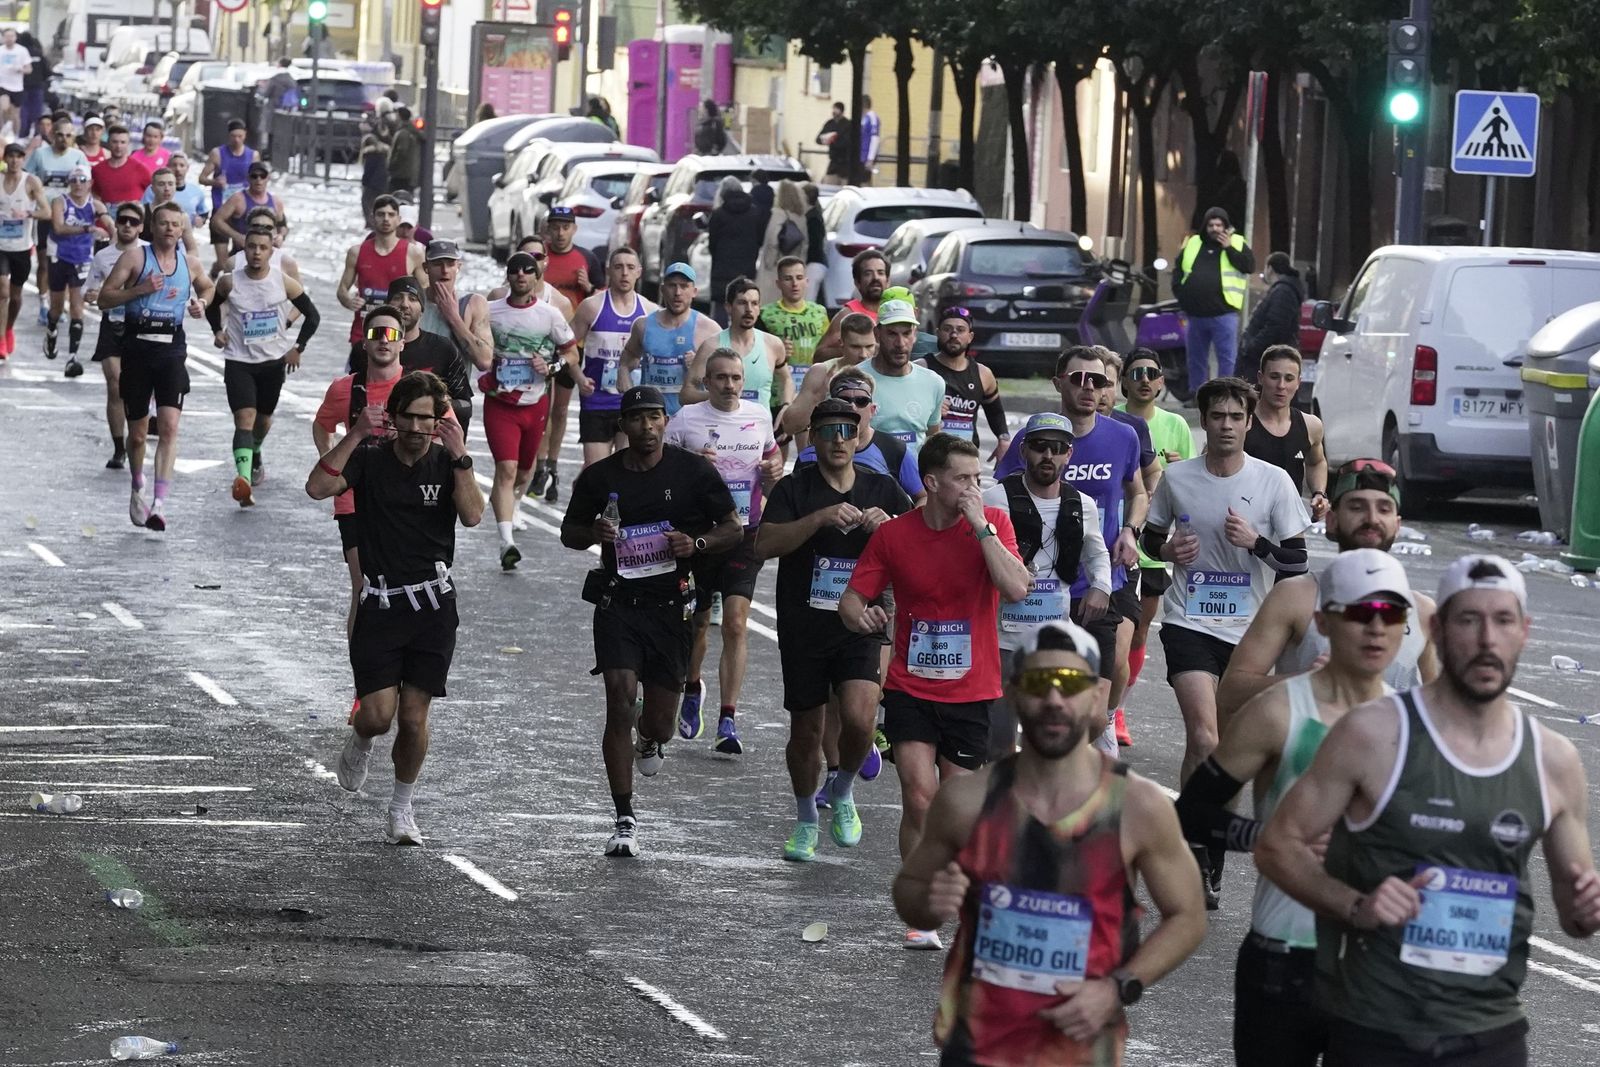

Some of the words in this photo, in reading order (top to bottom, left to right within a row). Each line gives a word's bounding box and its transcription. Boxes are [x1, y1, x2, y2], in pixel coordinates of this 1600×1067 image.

[1463, 401, 1495, 413] 9177
[1500, 403, 1524, 415] MFY
[419, 484, 441, 500] W
[739, 506, 750, 515] AS
[633, 542, 653, 552] 12111
[1209, 574, 1244, 584] ZURICH
[811, 588, 841, 599] AFONSO
[1209, 591, 1228, 600] 5595
[1199, 602, 1225, 614] TONI
[1229, 603, 1237, 614] D
[1002, 612, 1037, 622] BENJAMIN
[932, 624, 963, 633] ZURICH
[931, 642, 948, 650] 5669
[917, 652, 963, 665] GEORGE
[1451, 875, 1508, 895] ZURICH
[1017, 894, 1080, 916] ZURICH
[1409, 924, 1458, 947] TIAGO
[1462, 930, 1508, 950] VIANA
[979, 936, 1044, 967] PEDRO
[1051, 951, 1082, 972] GIL
